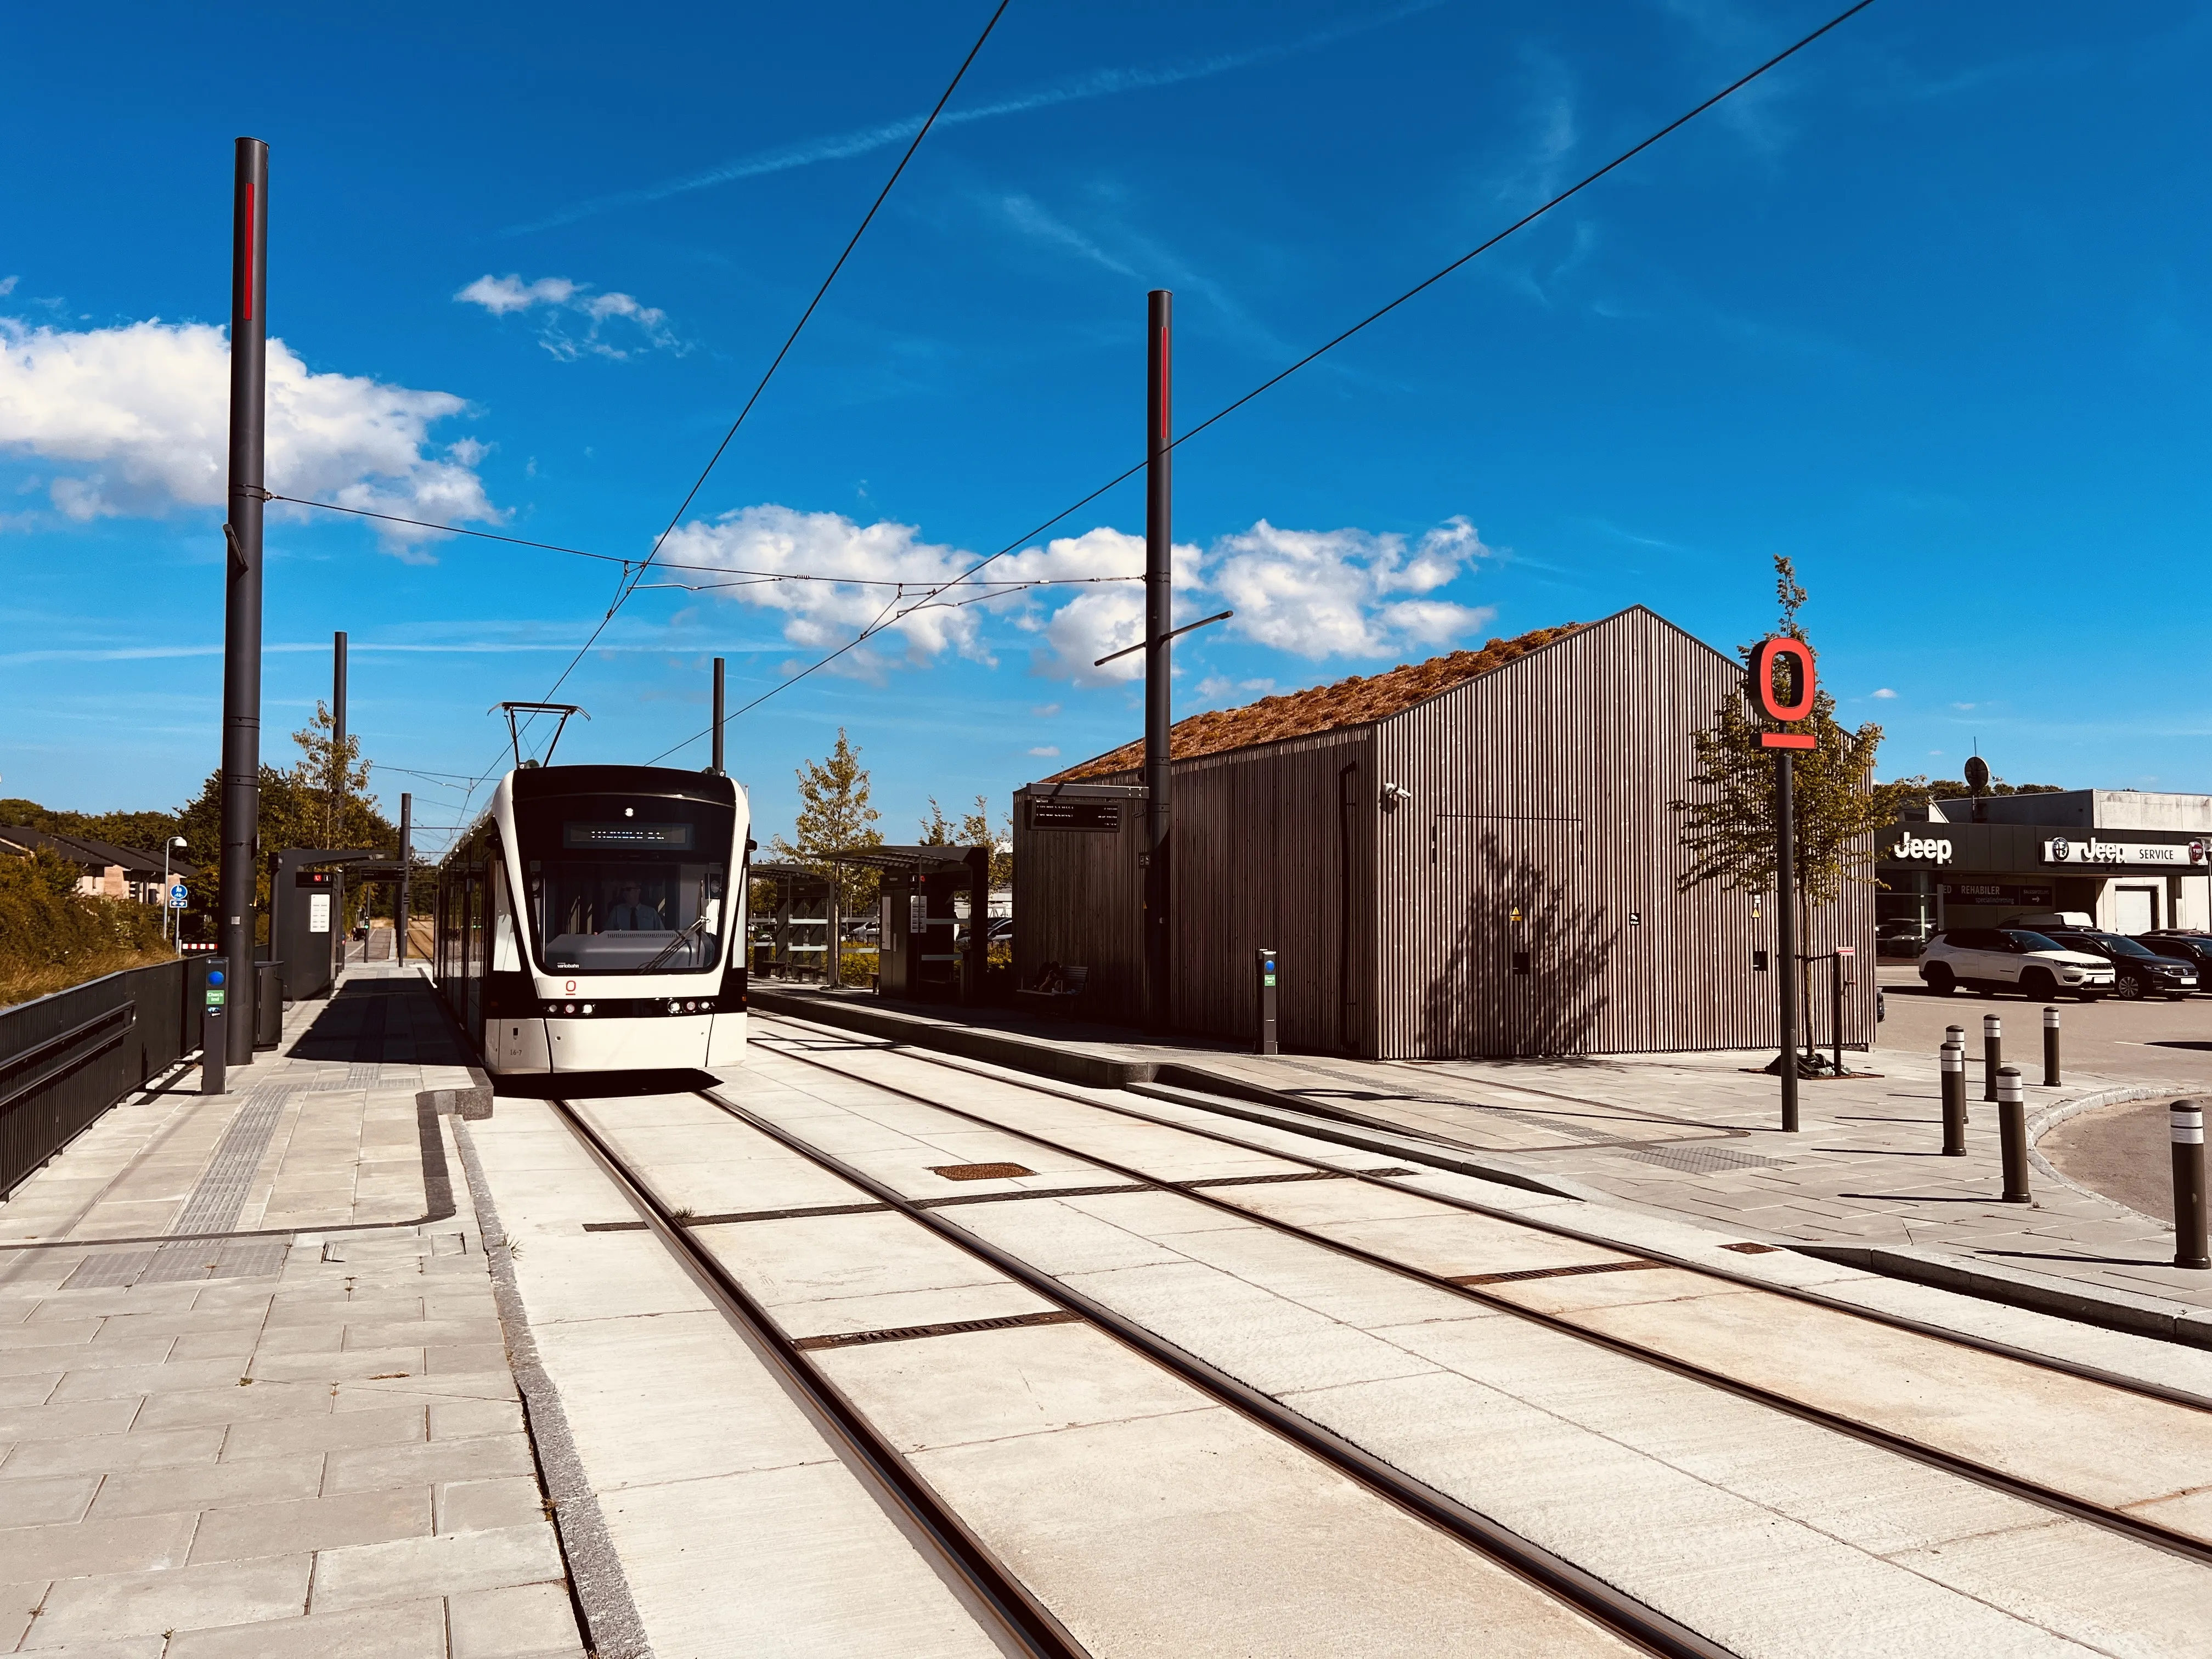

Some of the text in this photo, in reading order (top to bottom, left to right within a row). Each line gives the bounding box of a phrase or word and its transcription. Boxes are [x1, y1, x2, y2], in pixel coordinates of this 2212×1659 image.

[1894, 832, 1952, 864] Jeep
[2084, 837, 2124, 863] Jeep
[2140, 849, 2174, 860] SERVICE
[1961, 885, 2000, 895] REHABILER
